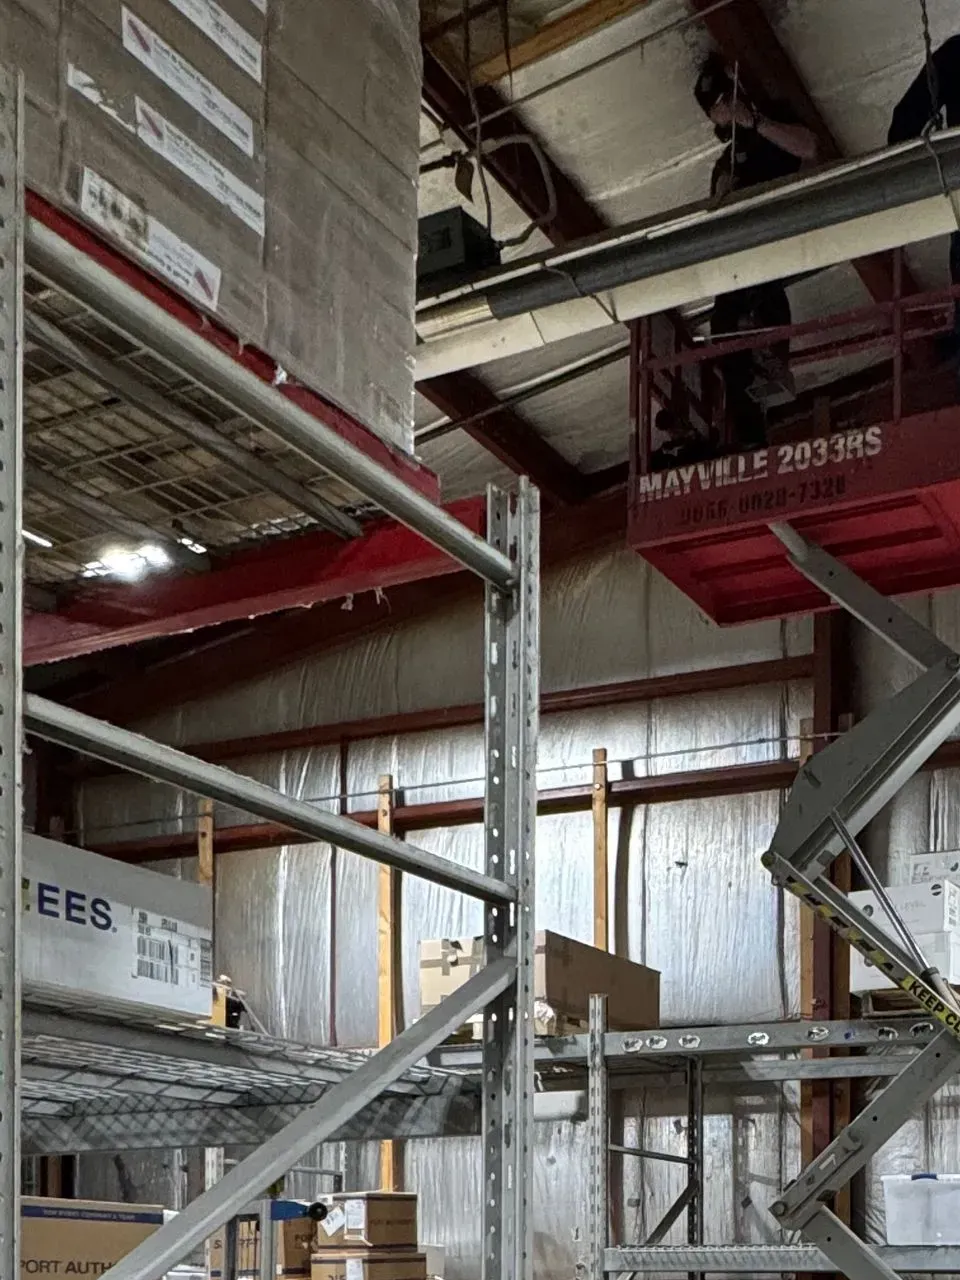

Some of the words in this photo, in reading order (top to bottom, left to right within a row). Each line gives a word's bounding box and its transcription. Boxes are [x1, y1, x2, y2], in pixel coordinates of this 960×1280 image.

[639, 450, 768, 502] MAYVILLE
[777, 426, 882, 474] 2033RS
[22, 877, 113, 931] EES
[909, 981, 945, 1012] KEEP
[65, 1261, 115, 1274] AUTH
